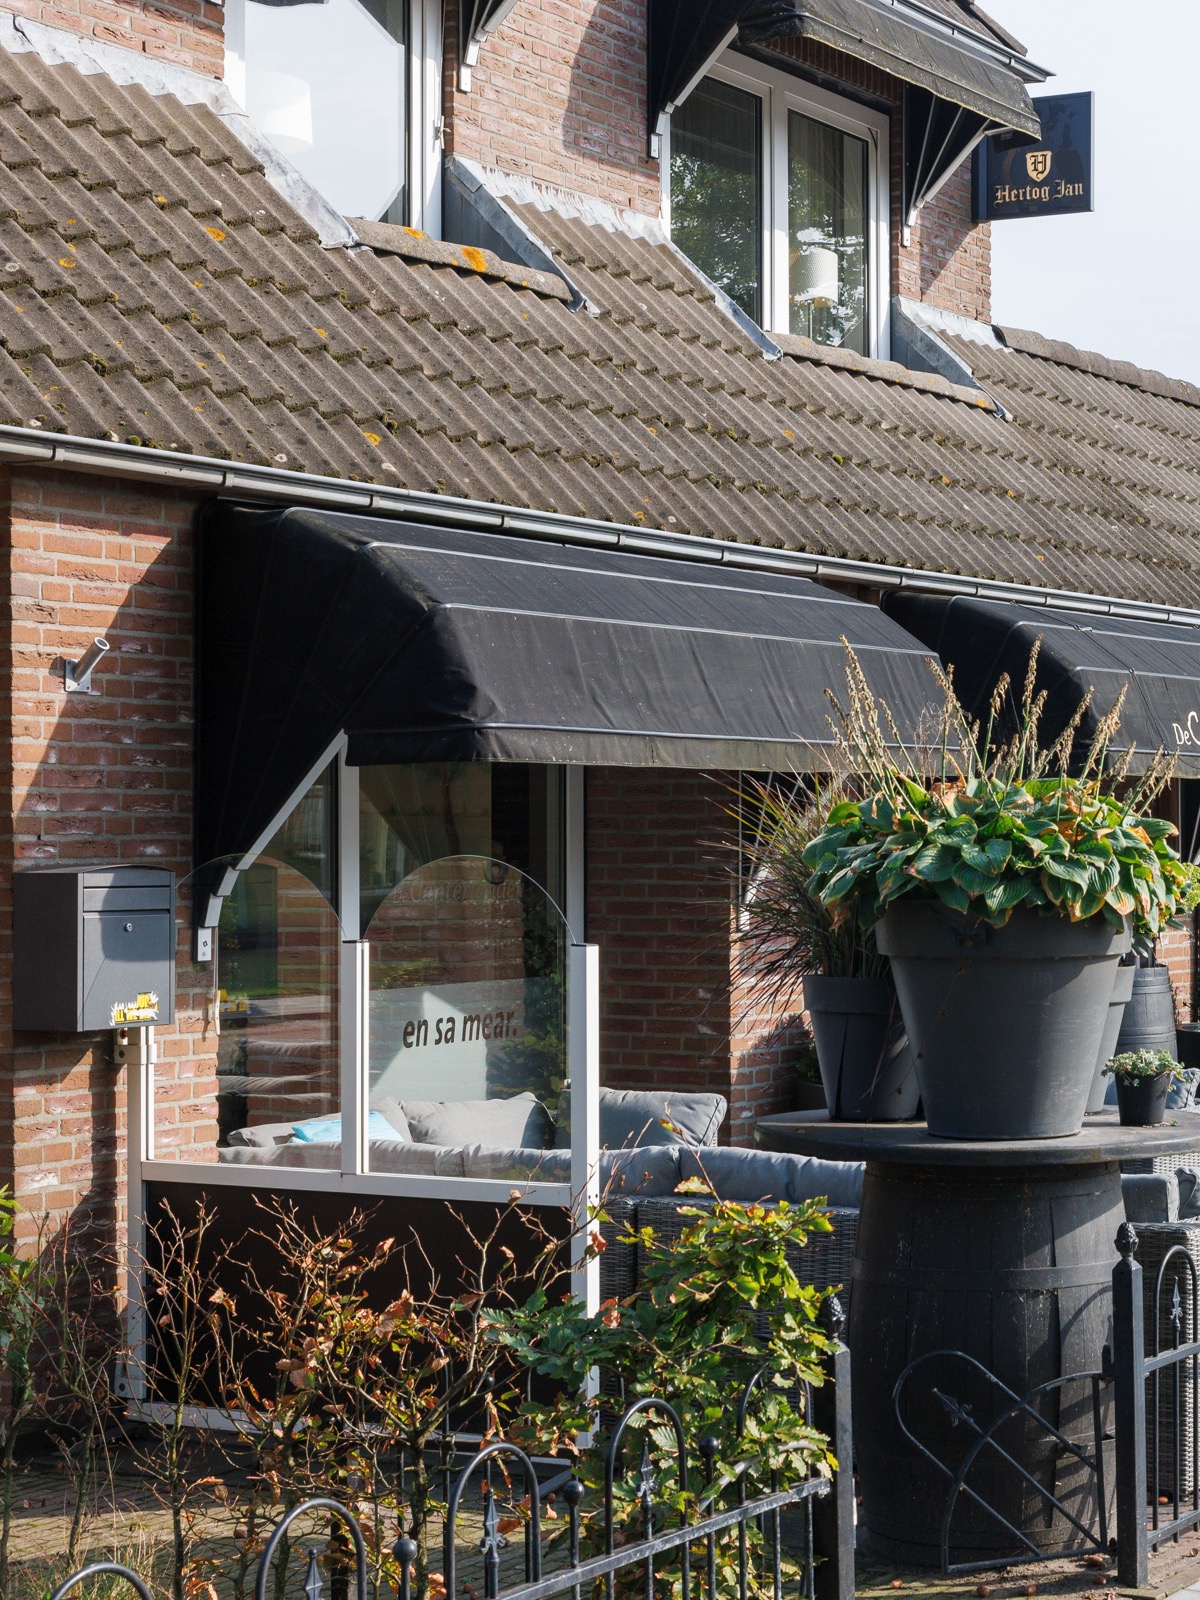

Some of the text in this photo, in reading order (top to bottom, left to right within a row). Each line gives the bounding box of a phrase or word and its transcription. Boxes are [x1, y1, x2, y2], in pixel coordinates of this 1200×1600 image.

[993, 179, 1084, 208] Hertog Jan
[1172, 723, 1191, 746] De
[402, 1009, 517, 1049] en sa mear.
